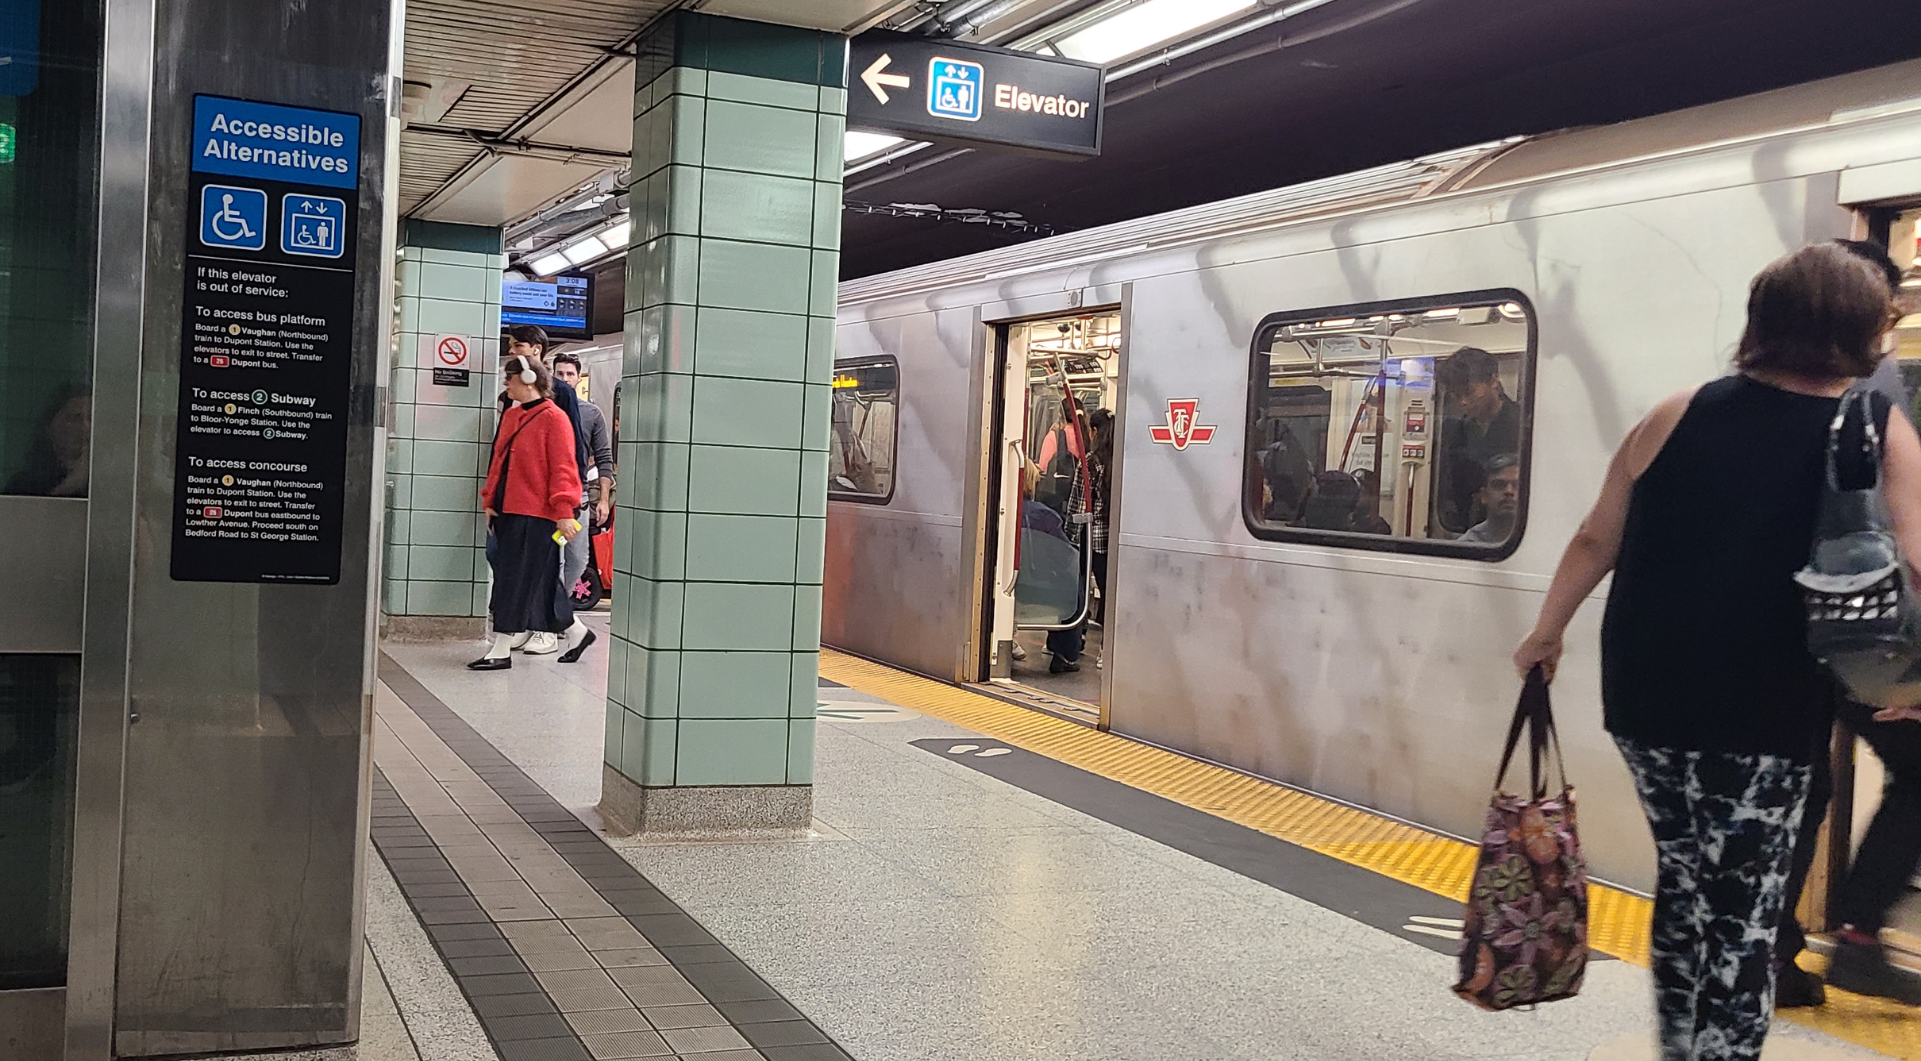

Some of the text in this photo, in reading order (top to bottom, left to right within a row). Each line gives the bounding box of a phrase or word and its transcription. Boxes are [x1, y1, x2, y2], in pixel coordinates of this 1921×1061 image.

[995, 84, 1090, 119] Elevator
[210, 114, 344, 147] Accessible
[204, 138, 349, 173] Alternatives
[198, 267, 276, 283] If this elevator
[197, 280, 289, 297] is out of service:
[196, 306, 326, 326] To access bus platform
[195, 324, 219, 332] Board
[242, 327, 276, 337] Vaughan
[278, 331, 328, 342] (Northbound)
[224, 337, 252, 346] Dupont
[254, 339, 283, 348] Station.
[194, 346, 229, 354] elevators
[292, 352, 323, 361] Transfer
[232, 359, 260, 367] Dupont
[192, 388, 207, 398] To
[210, 390, 250, 401] access
[271, 393, 316, 407] Subway
[238, 407, 260, 415] Finch
[262, 409, 313, 419] (Southbound)
[201, 415, 249, 426] Bloor-Yonge
[251, 418, 279, 427] Station.
[276, 431, 308, 440] Subway.
[188, 456, 308, 472] To access concourse
[236, 478, 271, 487] Vaughan
[273, 481, 323, 490] (Northbound)
[217, 488, 245, 497] Dupont
[224, 510, 253, 518] Dupont
[219, 520, 250, 528] Avenue.
[252, 521, 283, 529] Proceed
[261, 533, 289, 541] George
